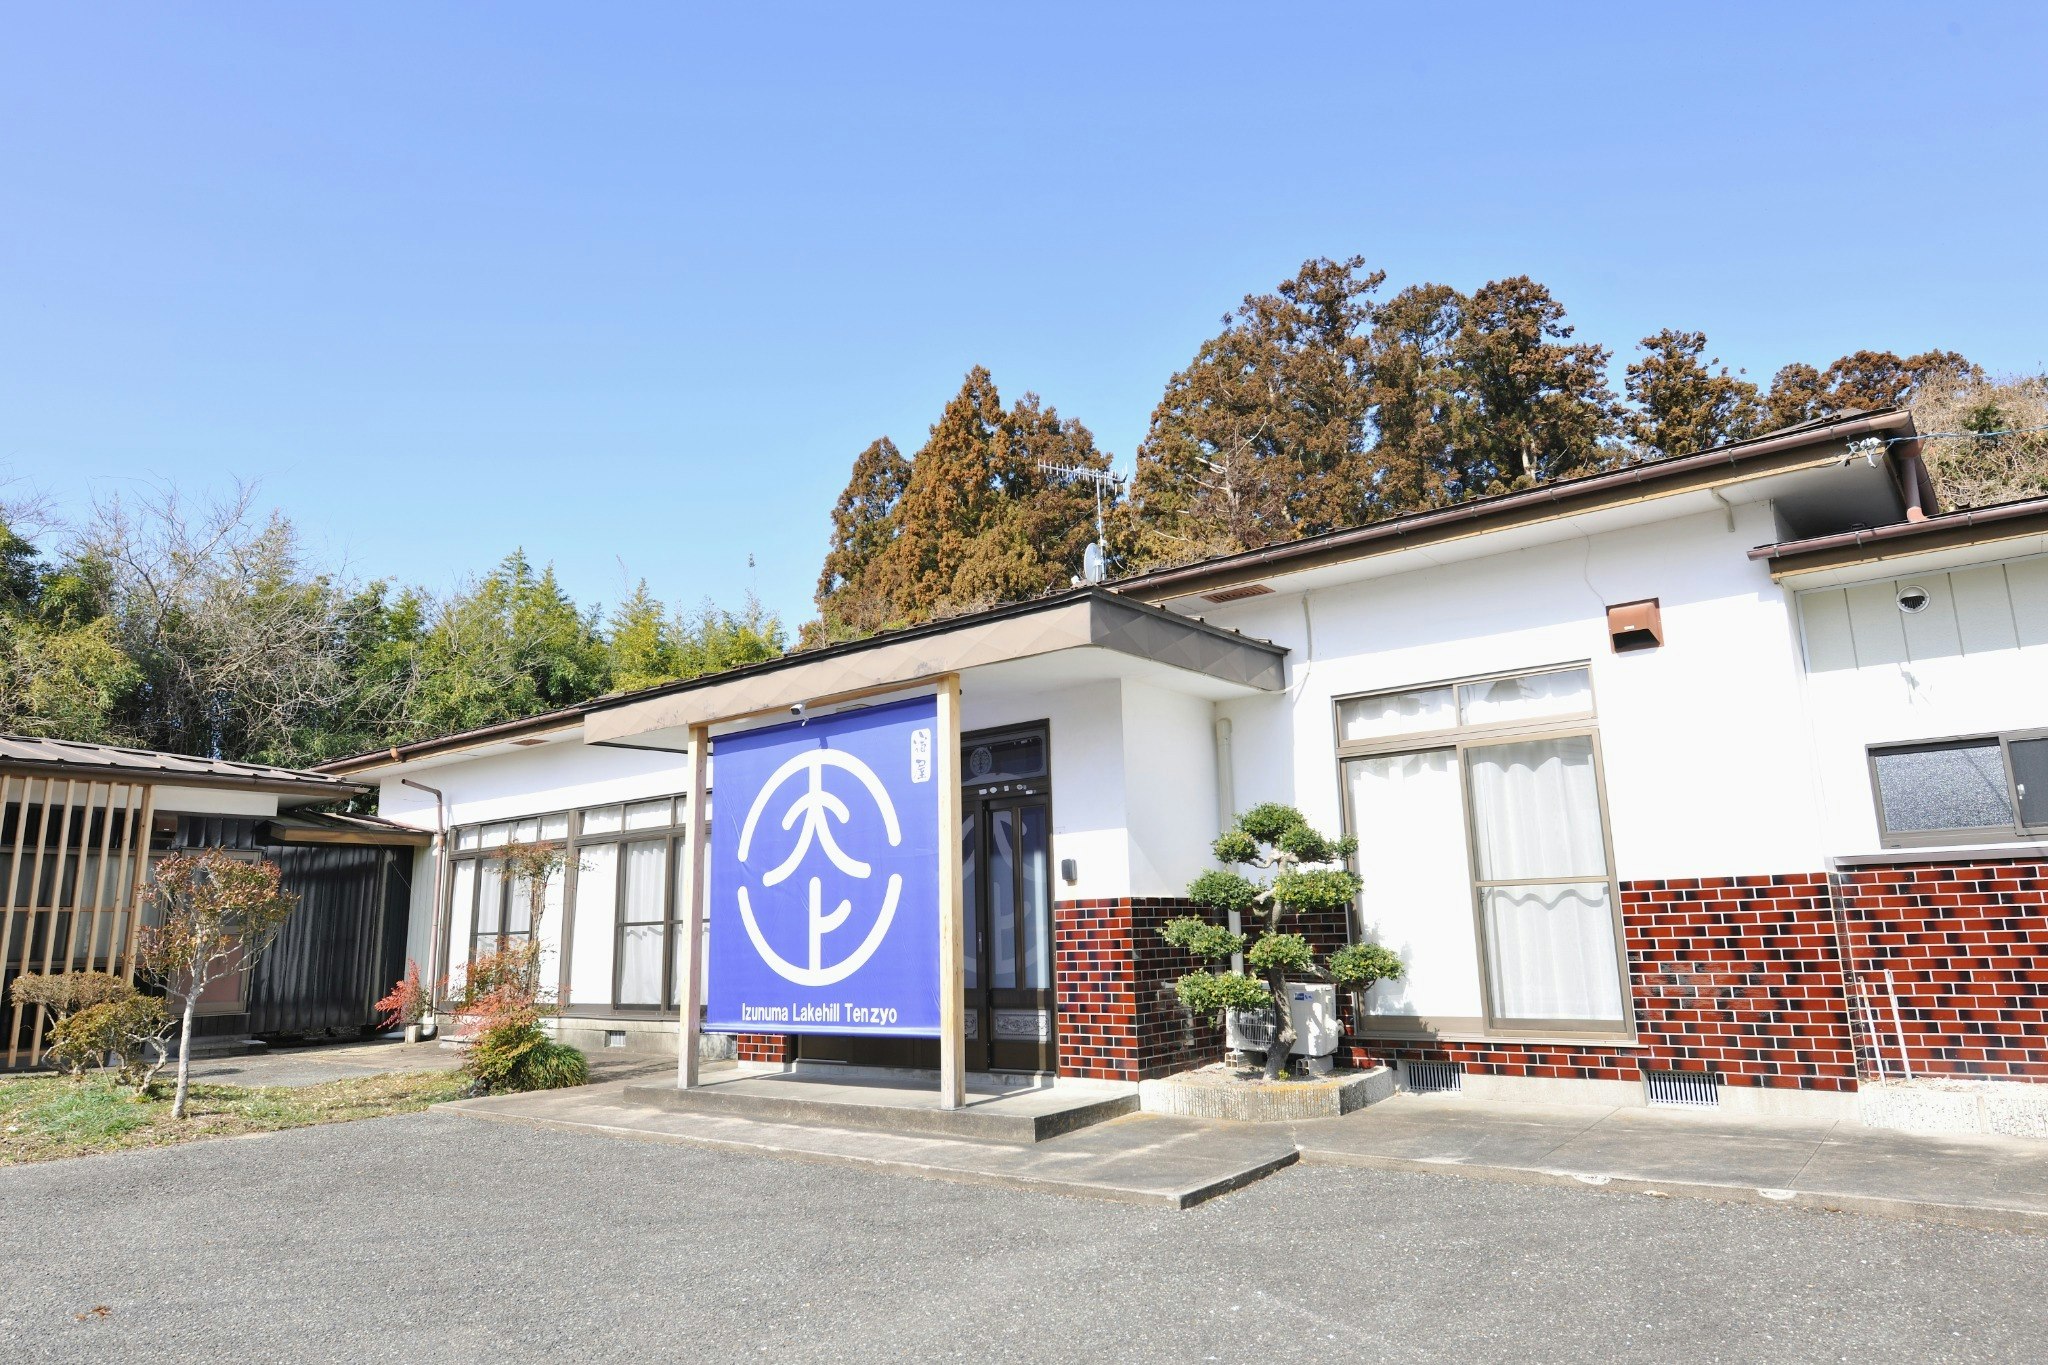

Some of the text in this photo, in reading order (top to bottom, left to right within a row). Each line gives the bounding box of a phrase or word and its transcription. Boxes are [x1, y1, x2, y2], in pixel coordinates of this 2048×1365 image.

[741, 1002, 898, 1025] Izunuma Lakehill Tenzyo
